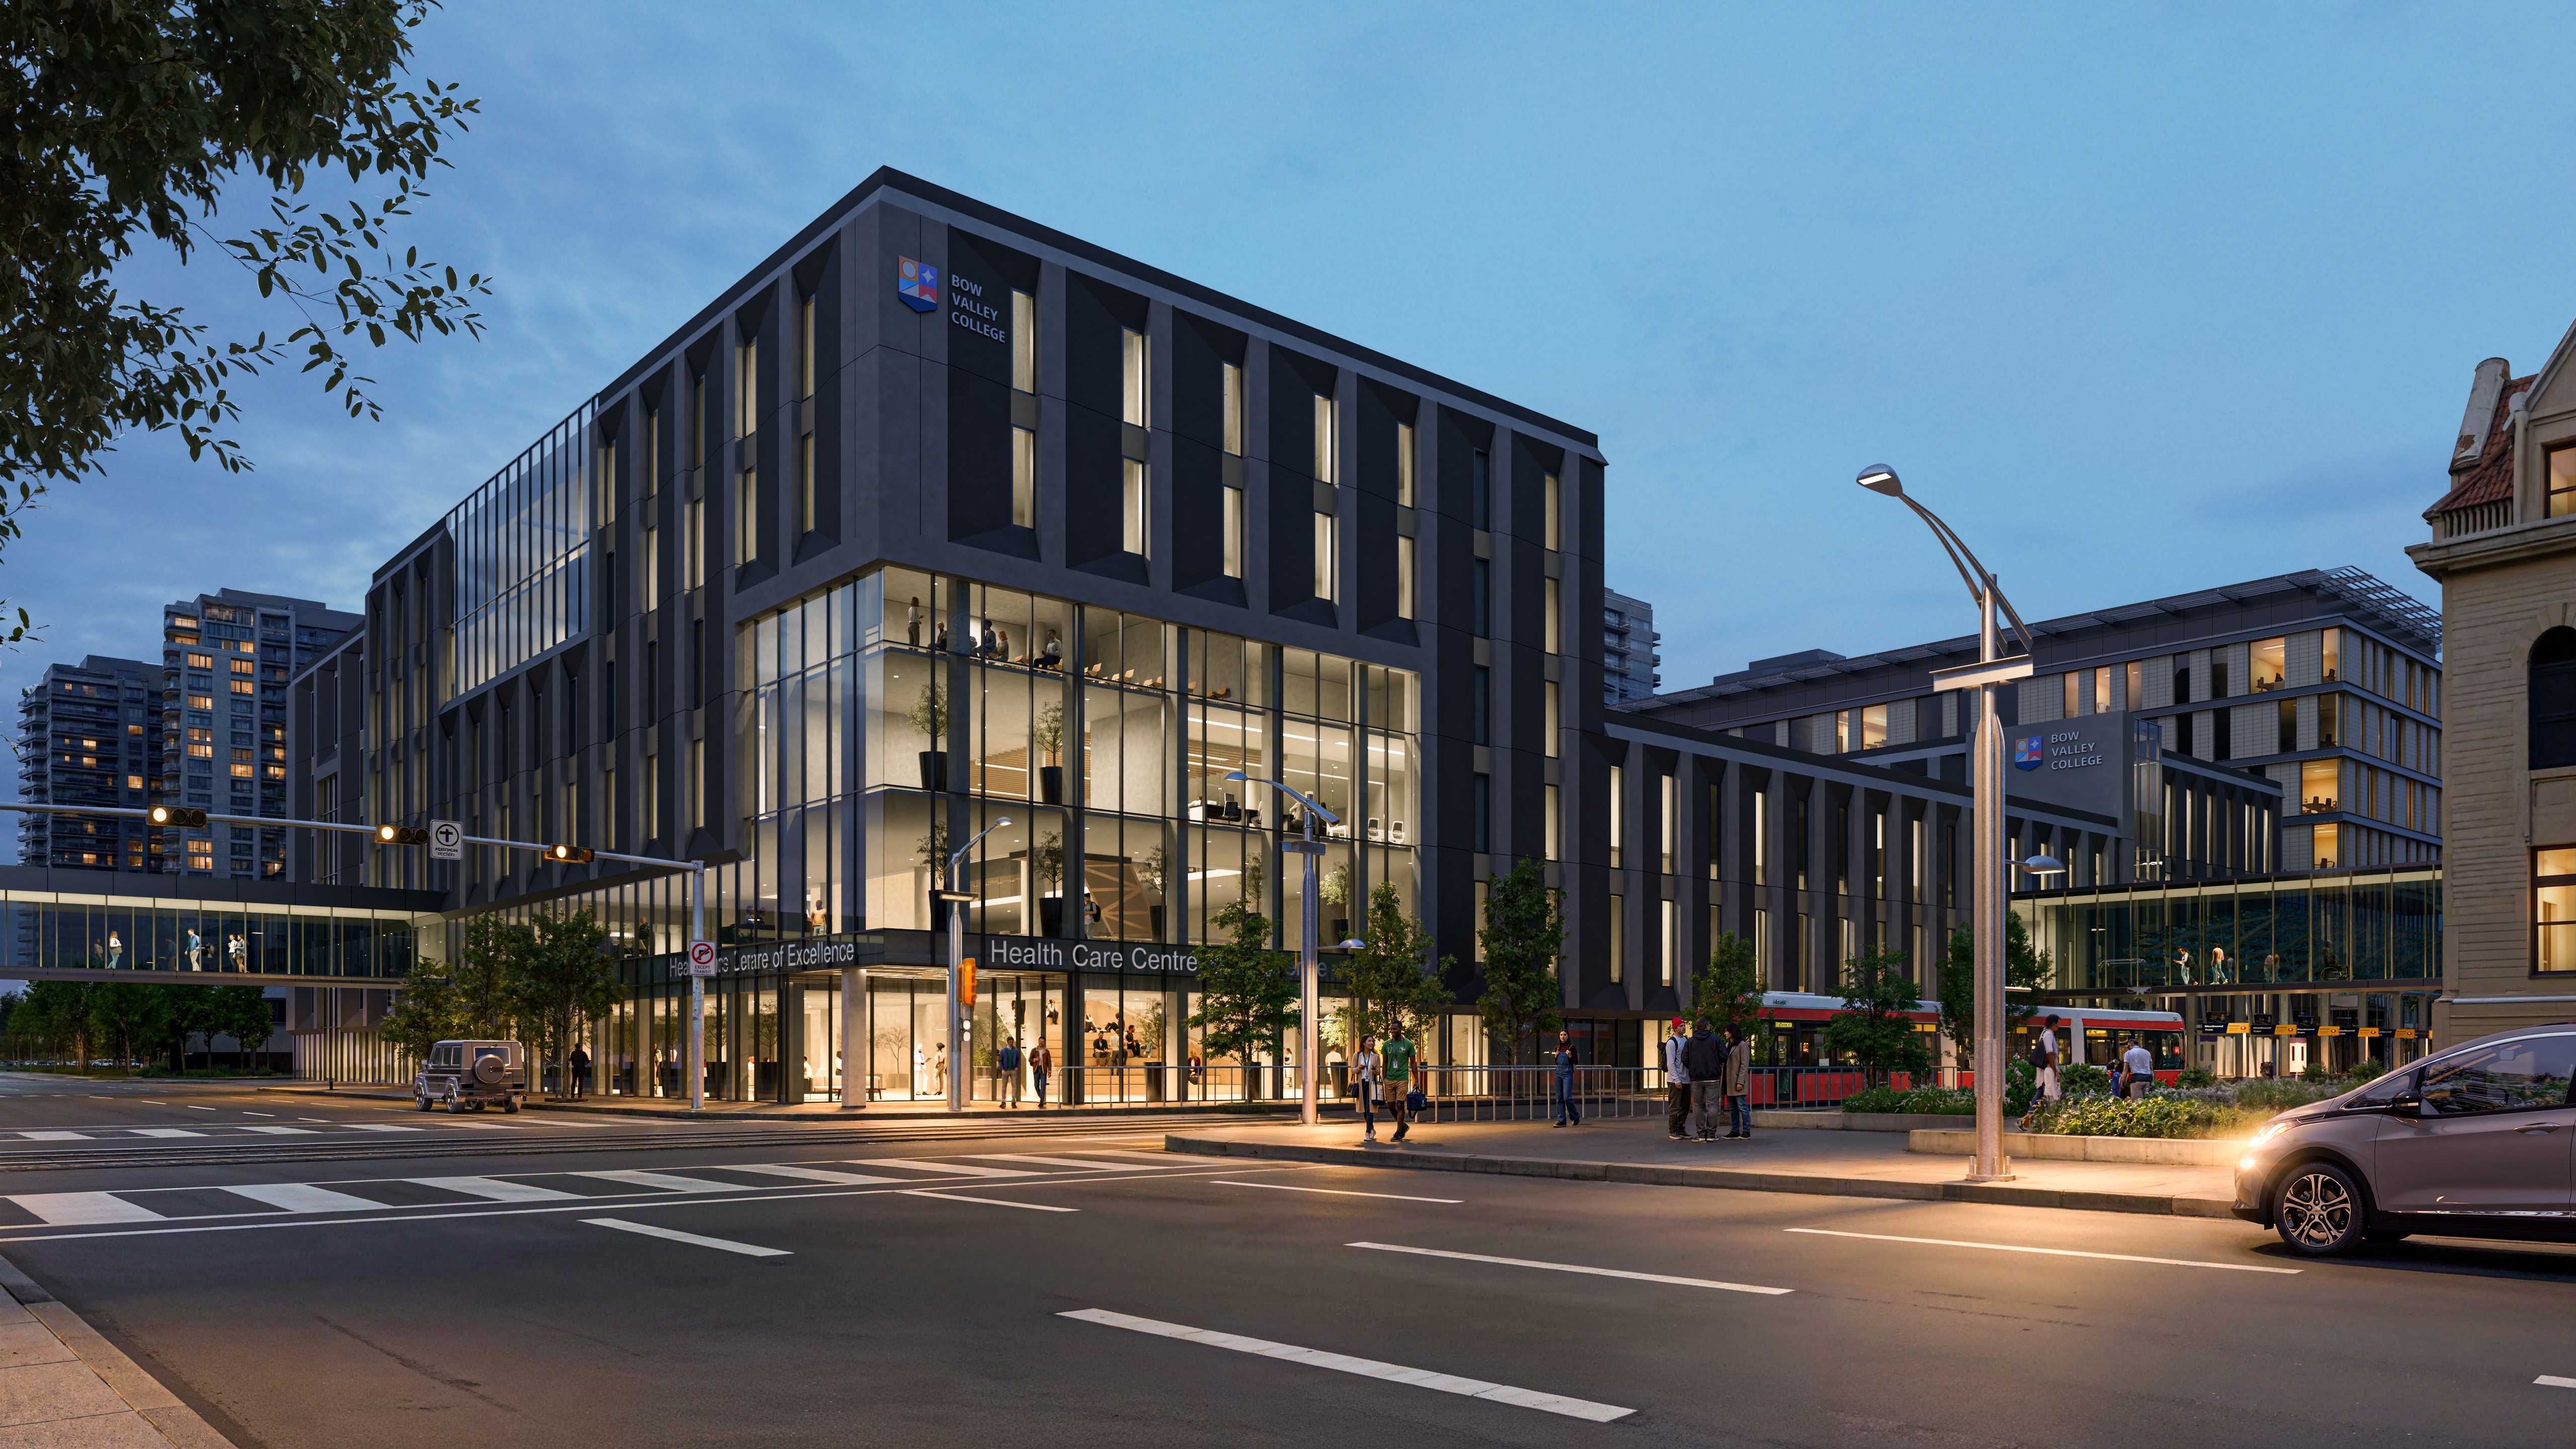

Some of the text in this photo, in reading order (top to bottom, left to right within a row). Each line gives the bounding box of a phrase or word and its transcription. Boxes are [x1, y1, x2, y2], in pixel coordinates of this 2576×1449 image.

[951, 274, 982, 297] BOW
[952, 292, 998, 321] VALLEY
[951, 311, 1005, 343] COLLEGE
[2051, 731, 2079, 744] BOW
[2052, 742, 2095, 757] VALLEY
[2051, 755, 2103, 770] COLLEGE
[670, 957, 689, 977] Hea
[773, 945, 784, 968] of
[788, 941, 854, 967] Excellence
[991, 940, 1197, 972] Health Care Centre
